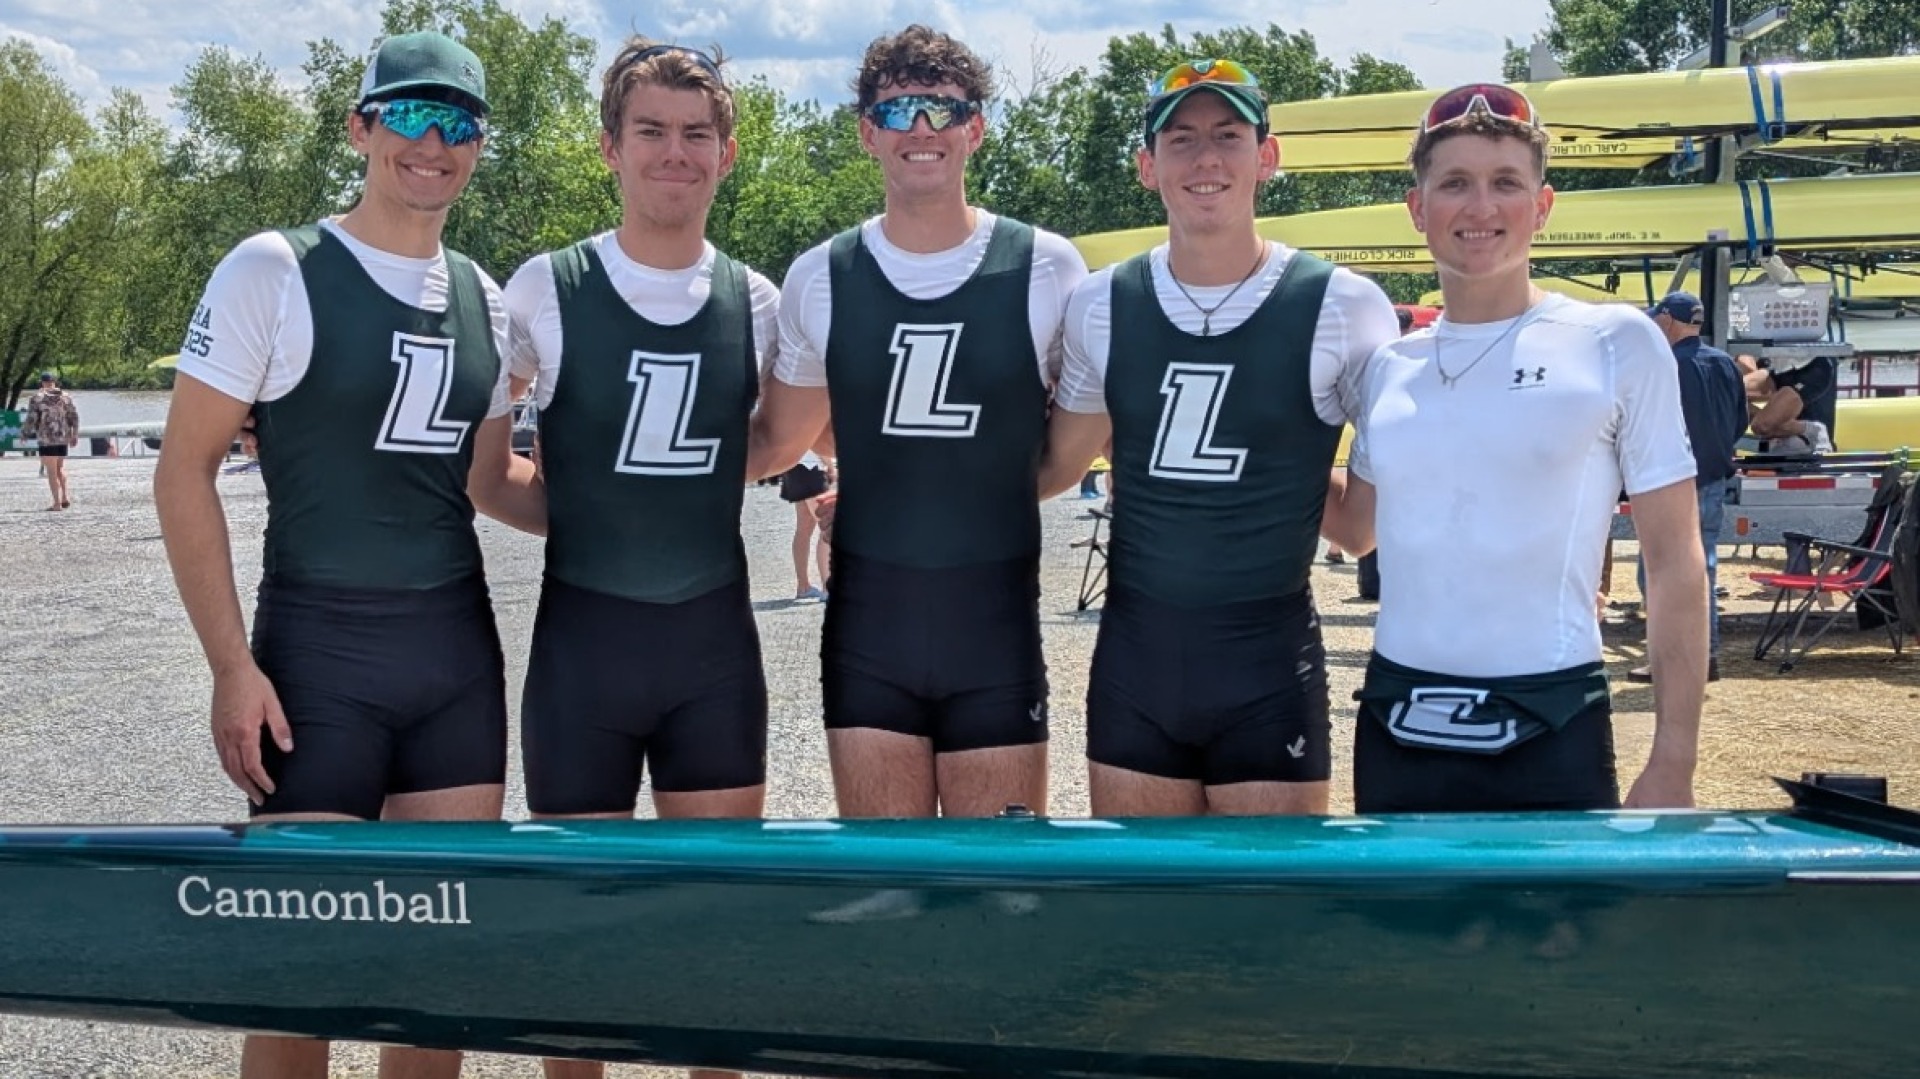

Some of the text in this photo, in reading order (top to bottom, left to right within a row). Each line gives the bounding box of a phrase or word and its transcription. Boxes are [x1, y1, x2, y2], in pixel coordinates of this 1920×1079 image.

[1595, 142, 1628, 154] CARL
[1323, 250, 1416, 261] RICK CLOTHIER
[374, 331, 471, 454] L
[614, 349, 722, 476] L
[891, 322, 982, 437] L
[1148, 361, 1249, 482] L
[177, 875, 471, 925] Cannonball
